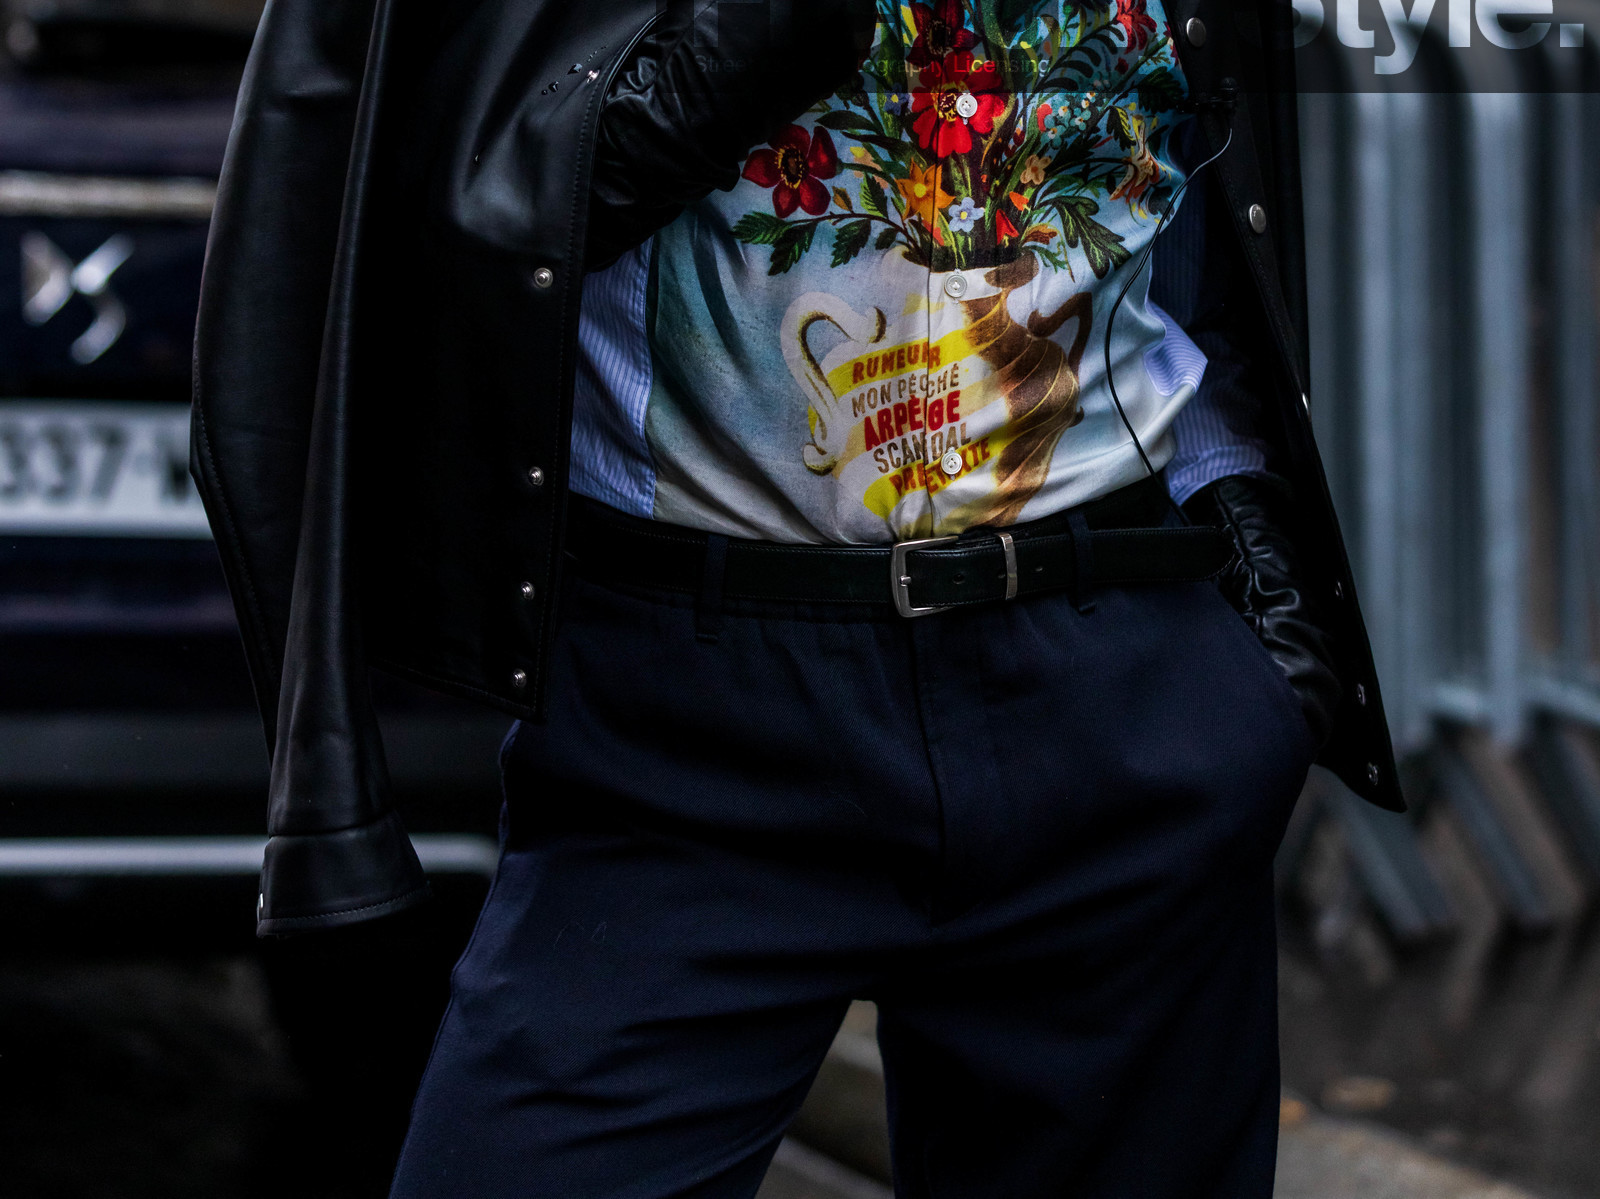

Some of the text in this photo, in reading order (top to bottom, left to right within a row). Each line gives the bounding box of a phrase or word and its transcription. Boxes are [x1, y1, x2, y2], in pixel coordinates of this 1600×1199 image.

[852, 342, 941, 385] RUMEUR
[851, 382, 892, 418] MON
[873, 422, 972, 474] SCANDAL
[889, 437, 991, 497] PRETXTE
